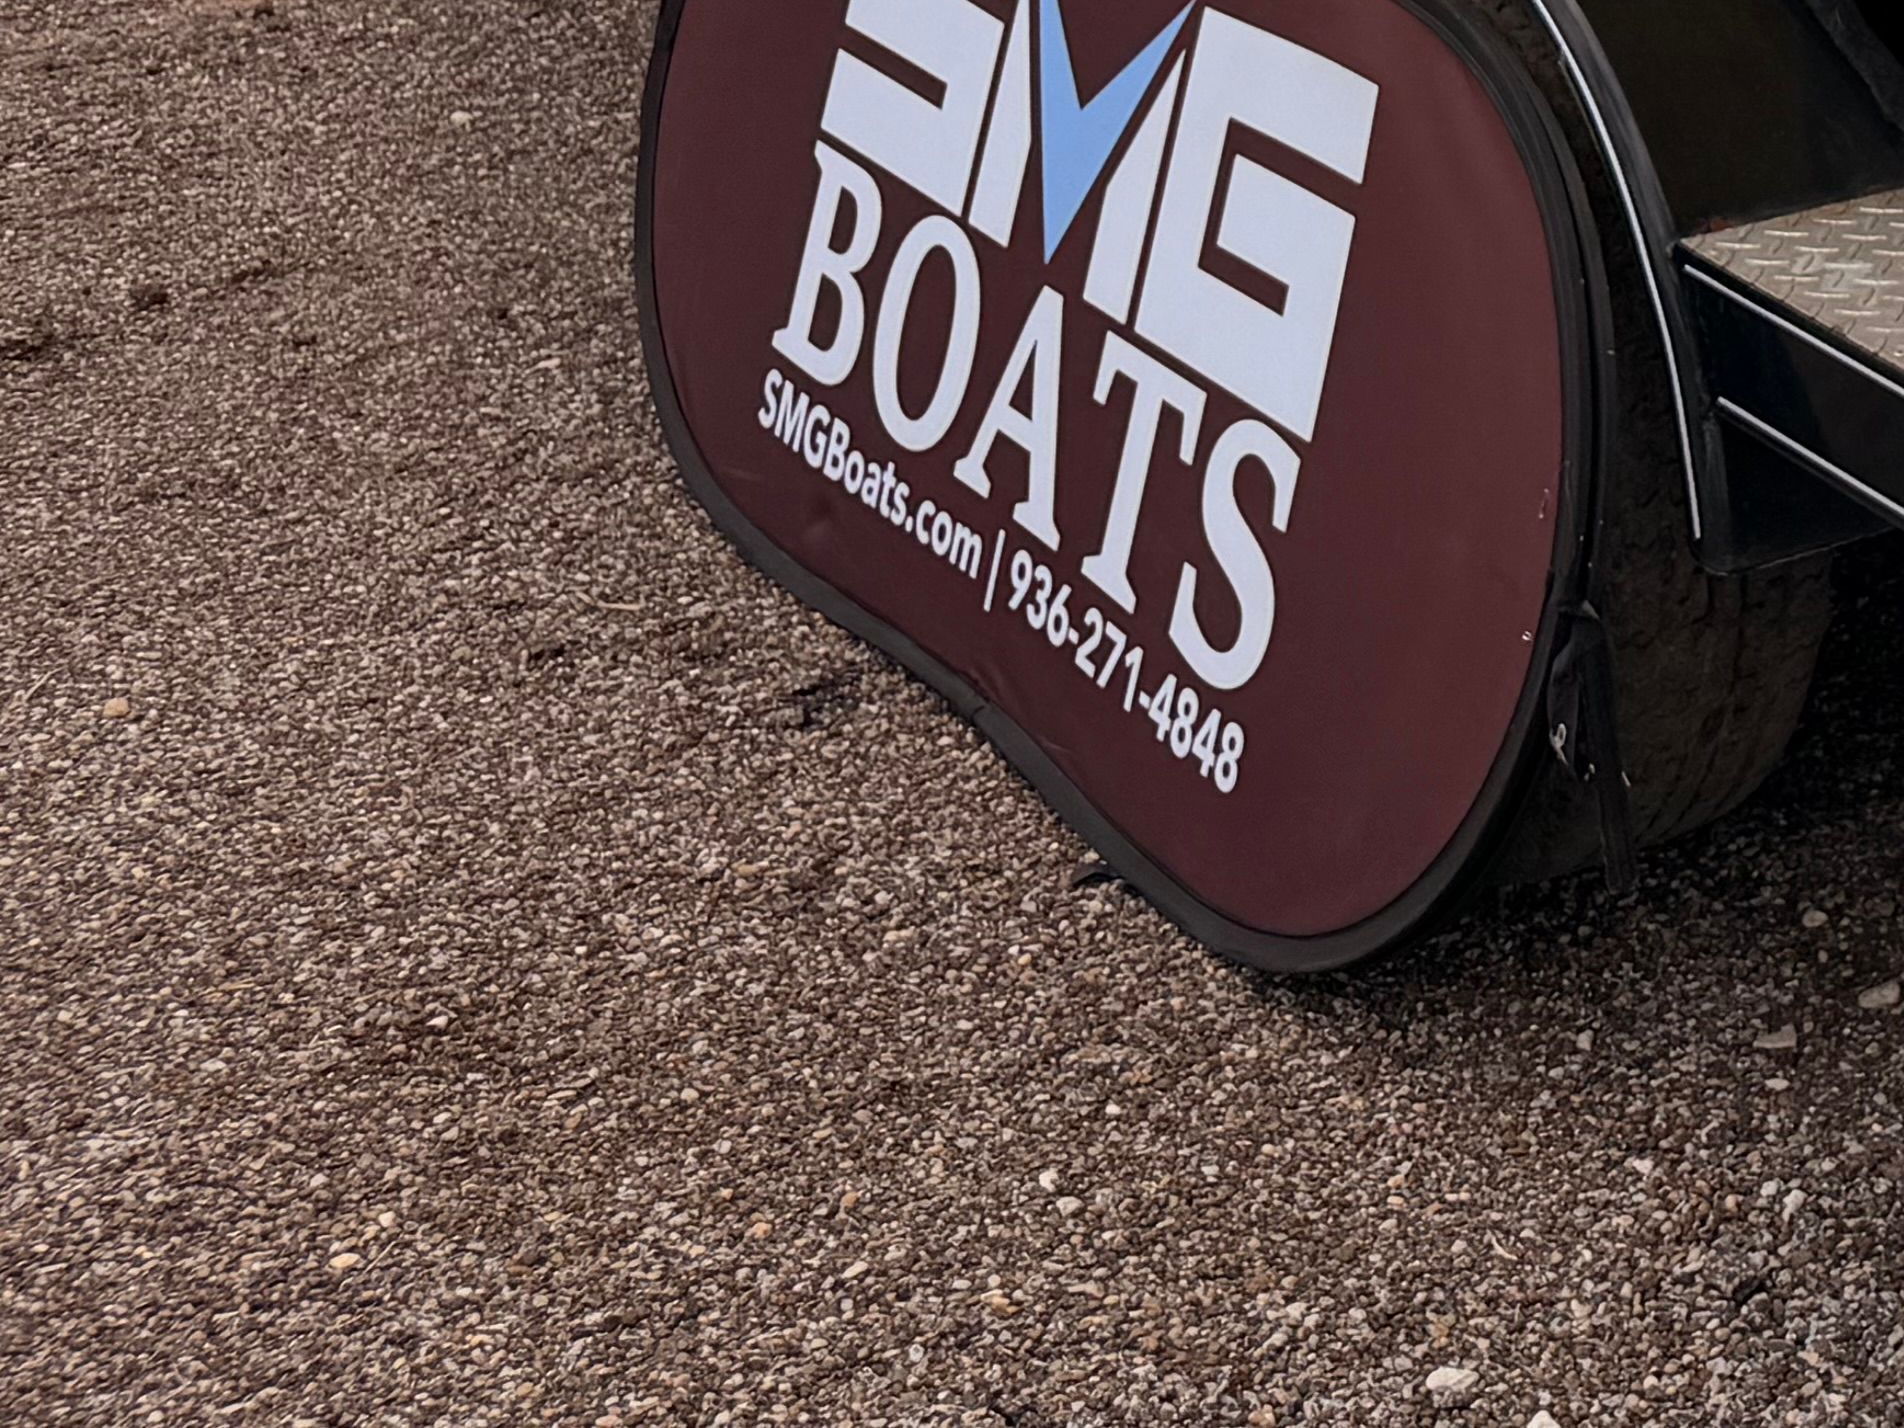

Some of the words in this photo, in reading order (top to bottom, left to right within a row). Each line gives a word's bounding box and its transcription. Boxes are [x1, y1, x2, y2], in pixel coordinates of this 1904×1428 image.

[758, 367, 984, 580] SMGBoats.com
[1005, 549, 1246, 794] 936-271-4848
[772, 139, 1304, 690] BOATS
